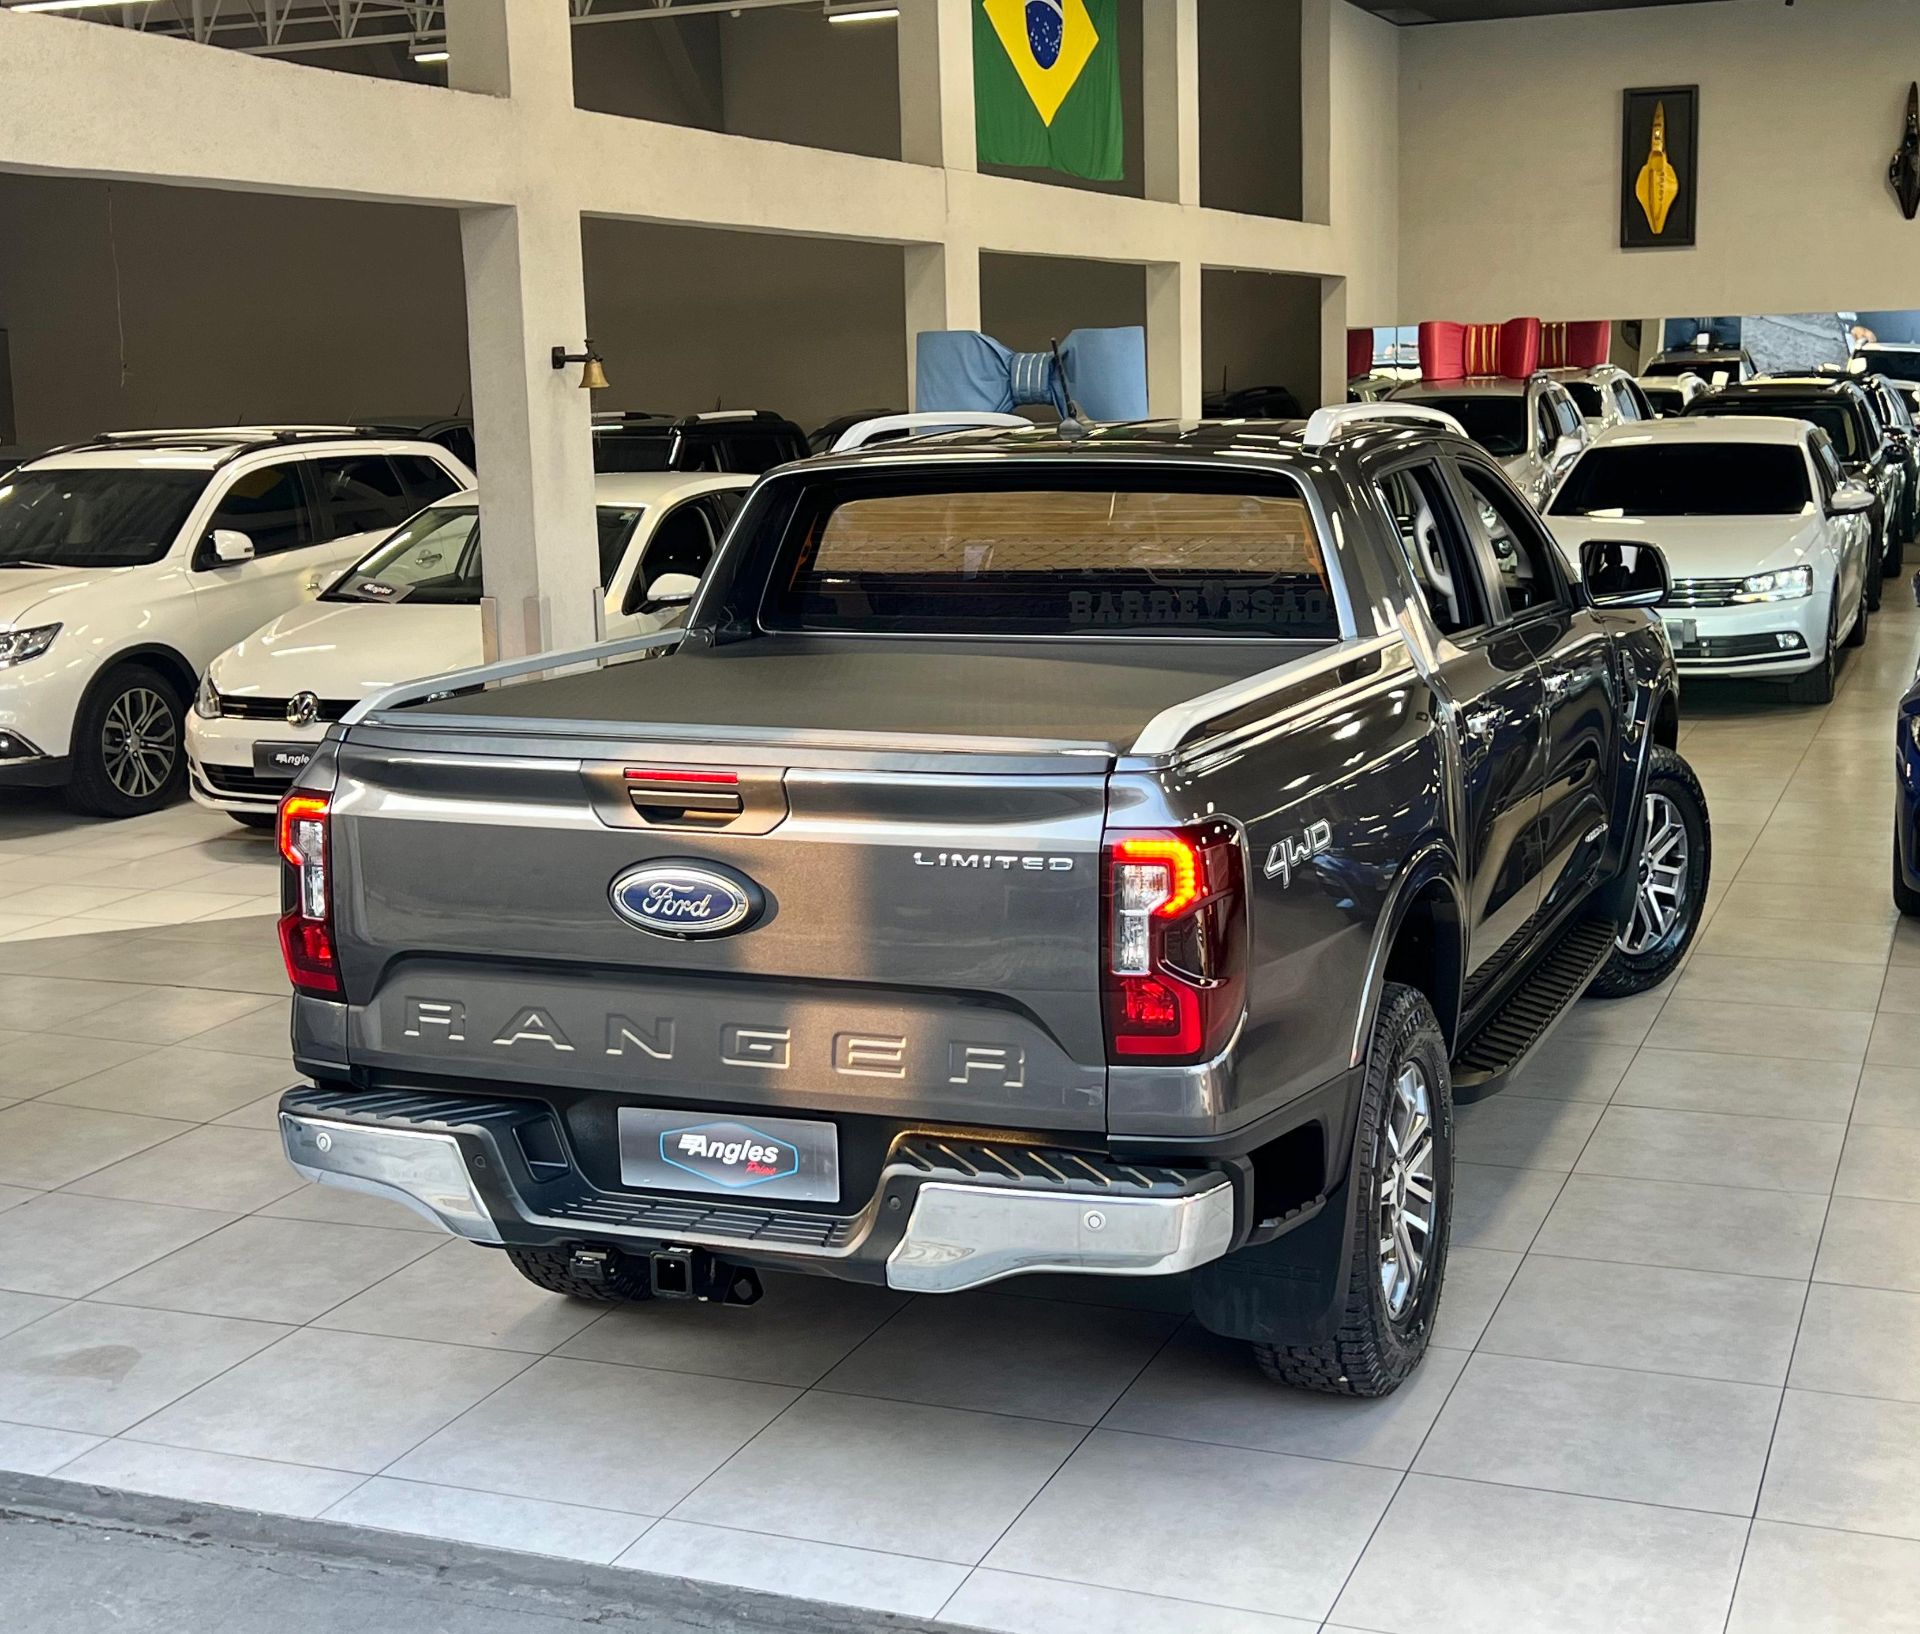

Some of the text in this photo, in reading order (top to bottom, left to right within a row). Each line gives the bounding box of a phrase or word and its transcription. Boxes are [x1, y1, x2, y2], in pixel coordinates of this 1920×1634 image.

[276, 753, 310, 766] Angle
[913, 851, 1074, 872] LIMITED
[1263, 817, 1333, 889] 4WD
[642, 882, 713, 918] Ford
[403, 996, 1025, 1089] RANGER
[678, 1133, 779, 1165] Angles
